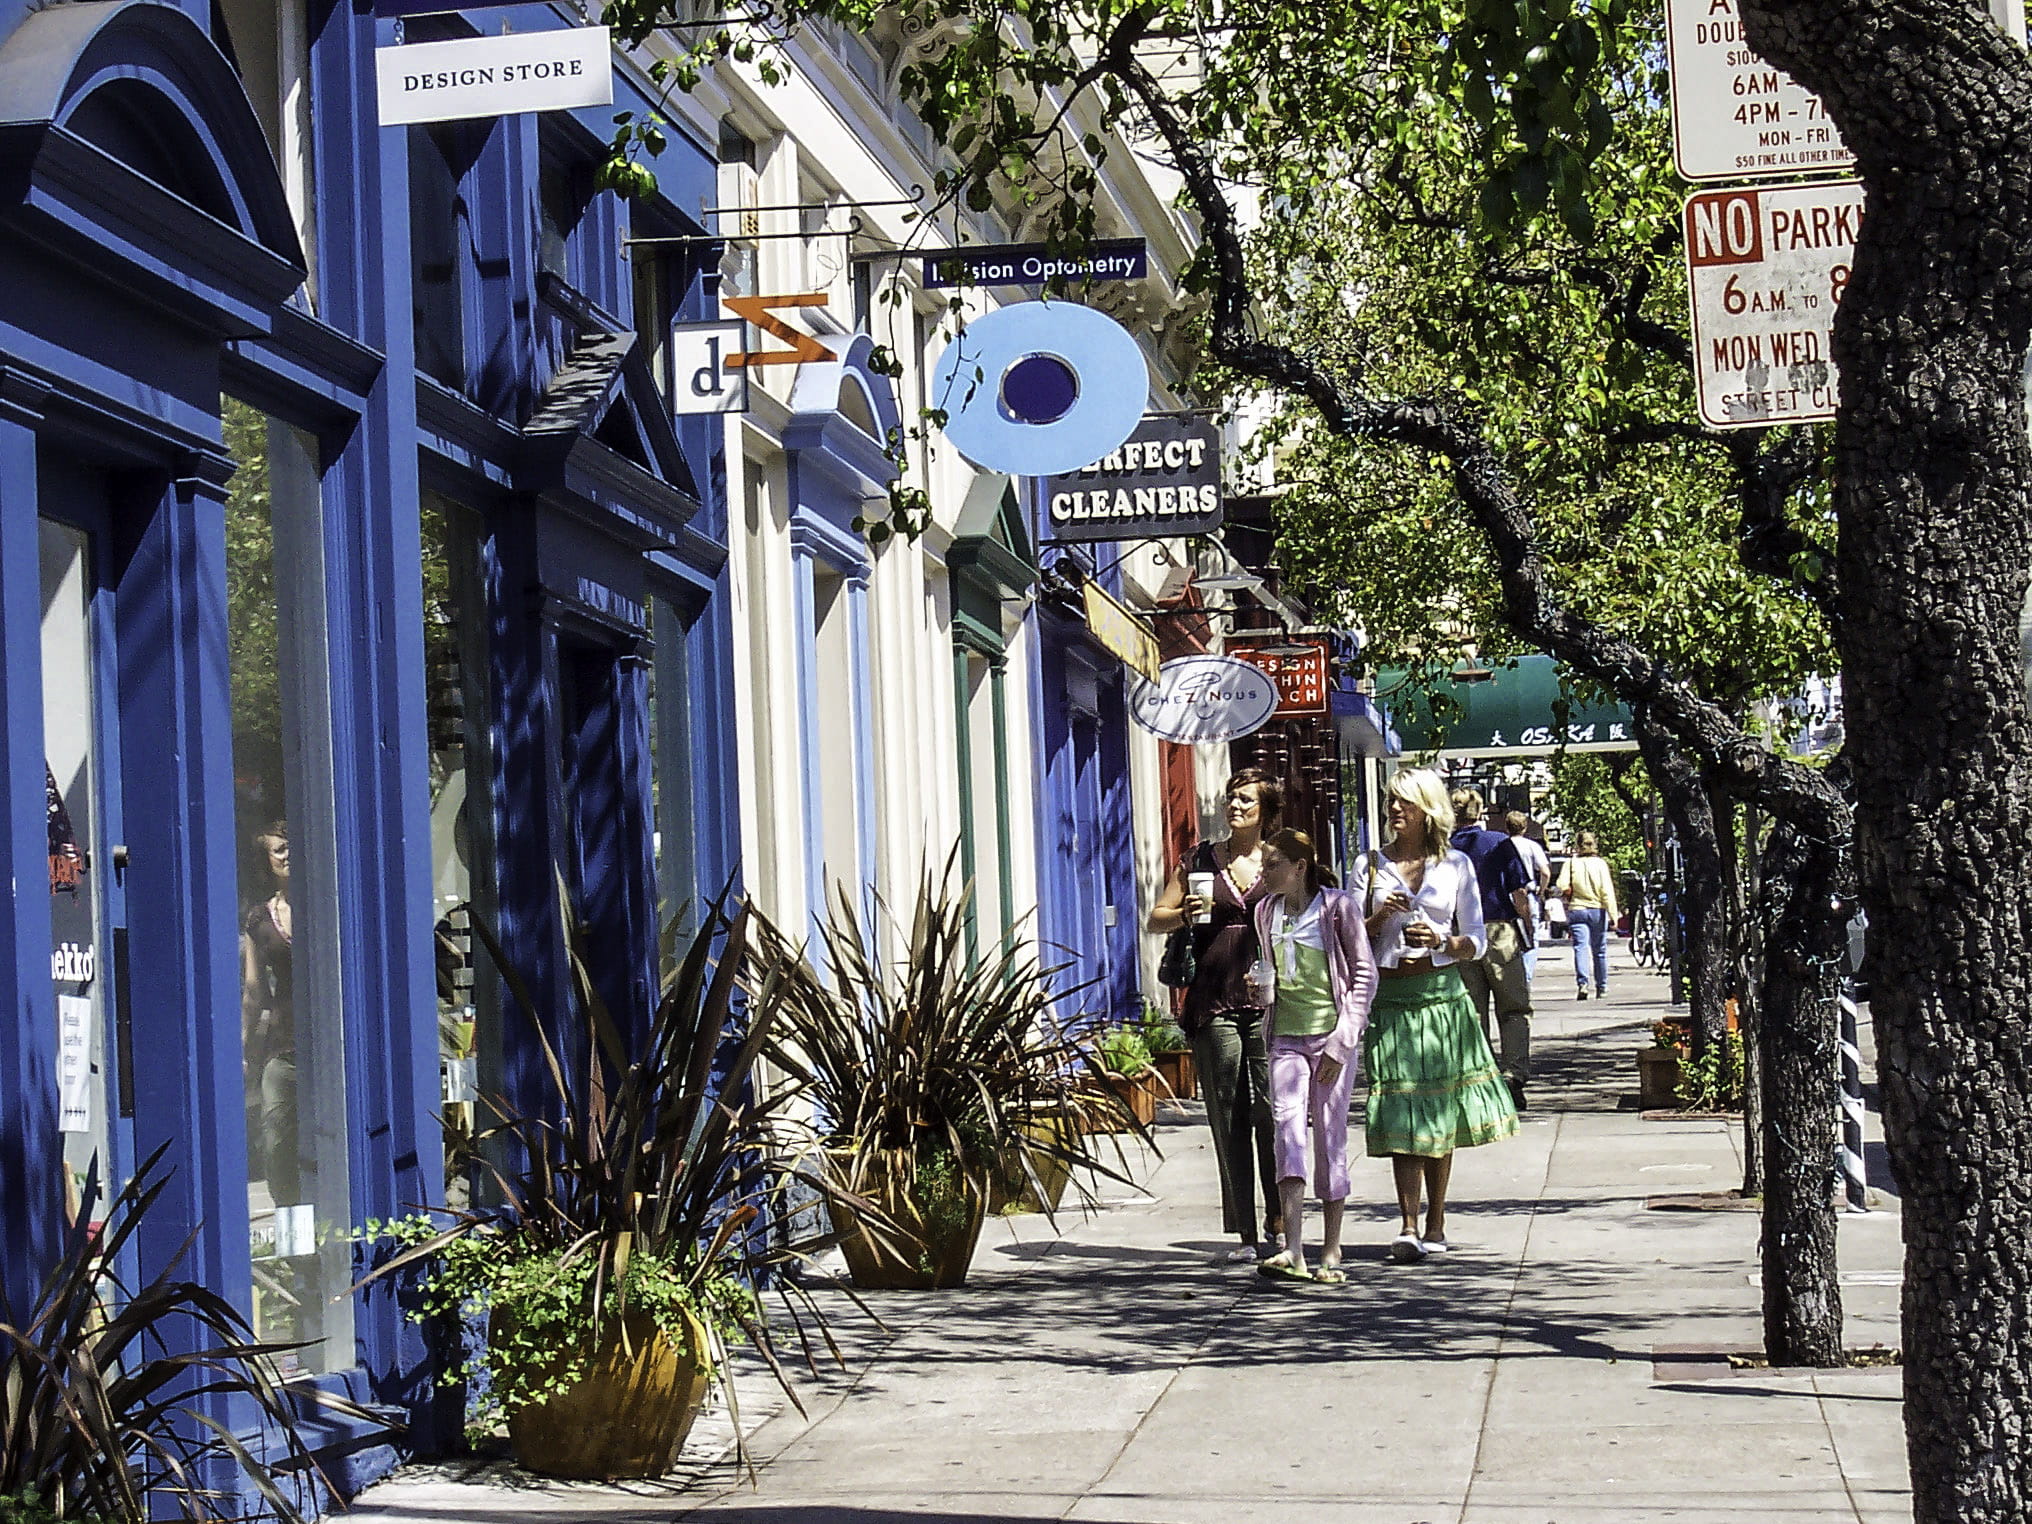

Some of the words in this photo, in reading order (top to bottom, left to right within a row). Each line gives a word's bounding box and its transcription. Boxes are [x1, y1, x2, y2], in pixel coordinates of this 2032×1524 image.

[404, 68, 494, 91] DESIGN
[503, 60, 583, 82] STORE
[1733, 72, 1779, 96] 6AM
[1734, 102, 1780, 125] 4PM
[1759, 131, 1790, 147] MON
[1807, 128, 1830, 143] FRI
[1735, 156, 1755, 168] $50
[1758, 154, 1777, 166] FINE
[1780, 152, 1797, 164] ALL
[1799, 150, 1828, 163] OTHER
[1694, 200, 1752, 258] NO
[1023, 257, 1136, 281] Optometry
[1802, 294, 1818, 309] TO
[1081, 438, 1207, 473] RFECT
[1051, 485, 1218, 521] CLEANERS
[1147, 692, 1196, 706] CHEZ
[1209, 690, 1257, 701] NOUS
